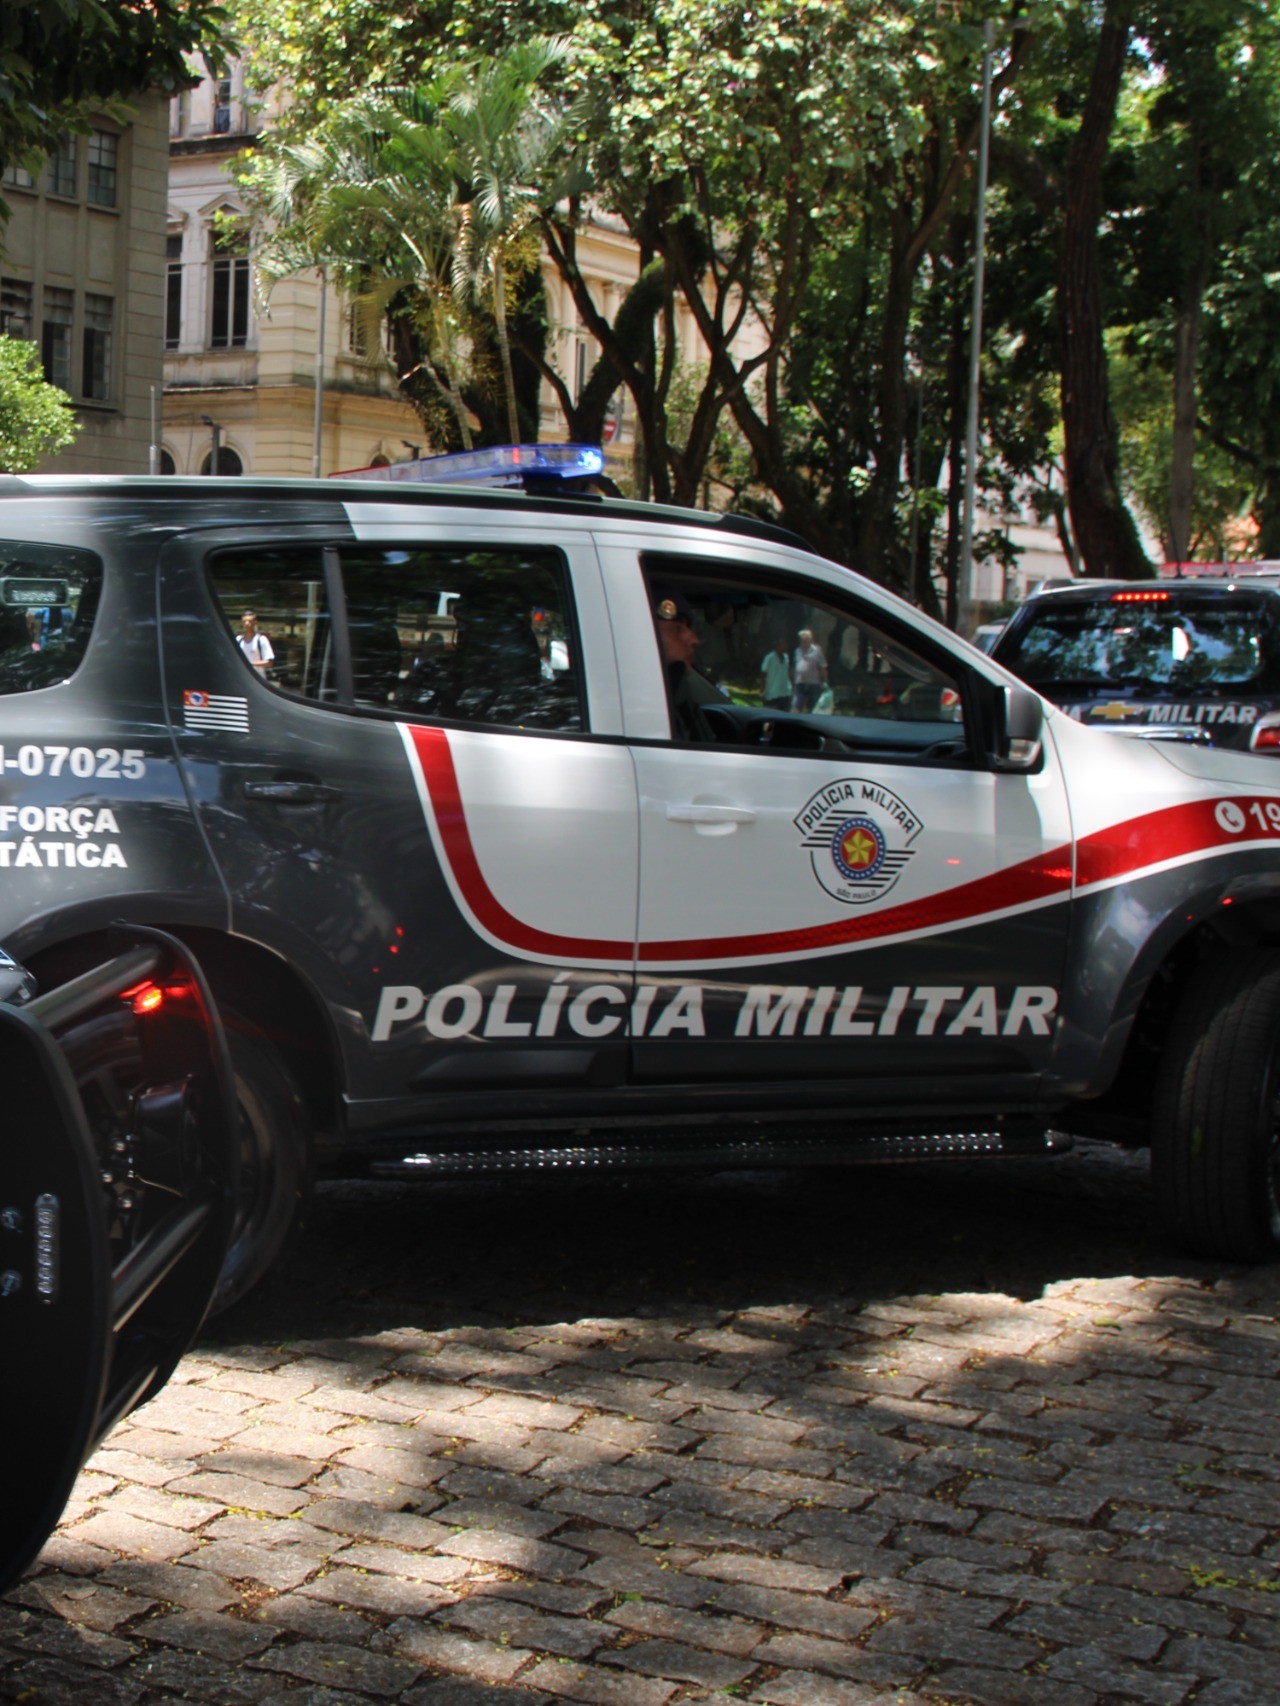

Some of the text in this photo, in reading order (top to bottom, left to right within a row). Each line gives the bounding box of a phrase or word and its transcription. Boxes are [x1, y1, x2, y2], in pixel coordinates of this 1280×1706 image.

[1147, 704, 1258, 724] MILITAR
[802, 784, 916, 834] POLÍCIA MILITAR
[371, 972, 1059, 1042] POLÍCIA MILITAR
